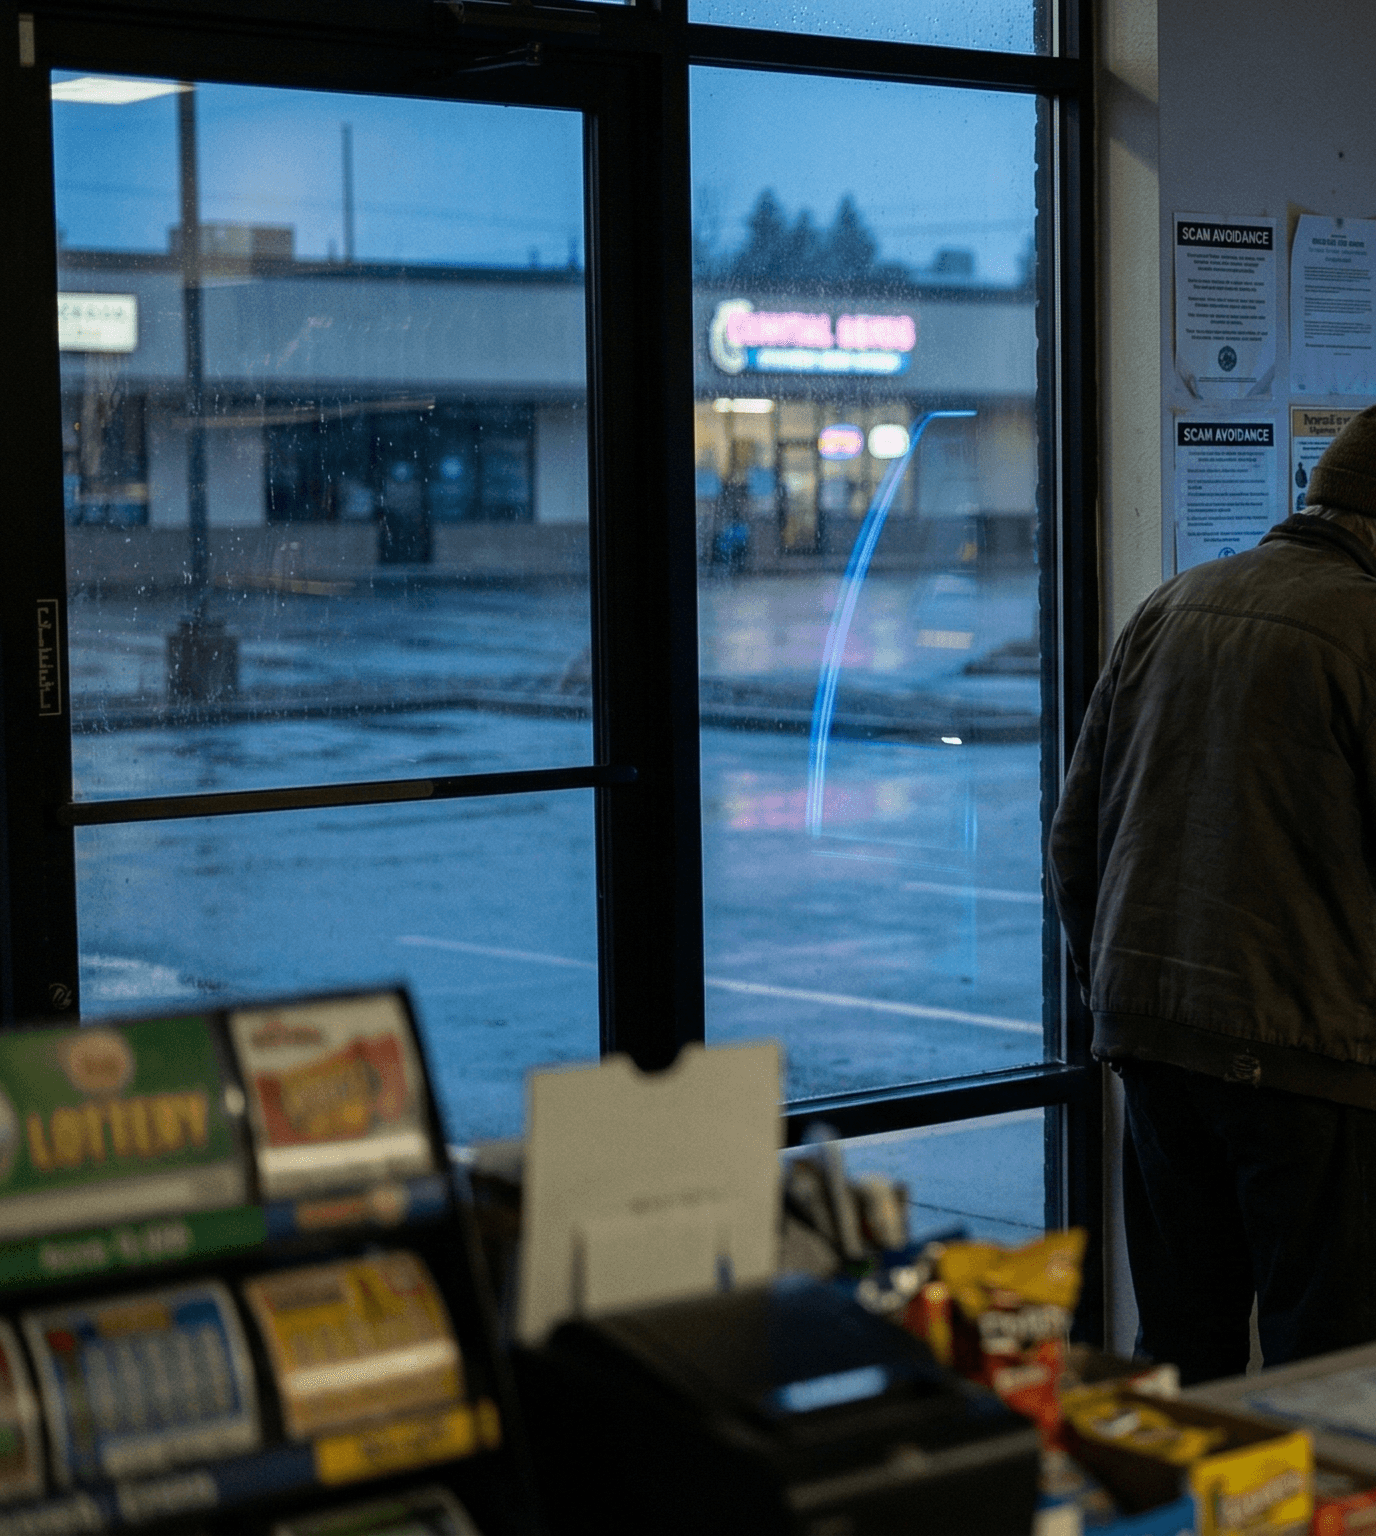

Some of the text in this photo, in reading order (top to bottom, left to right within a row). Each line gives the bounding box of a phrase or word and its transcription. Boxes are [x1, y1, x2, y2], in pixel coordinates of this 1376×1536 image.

[1212, 228, 1270, 245] AVOIDANCE
[1183, 427, 1270, 442] SCAM AVOIDANCE
